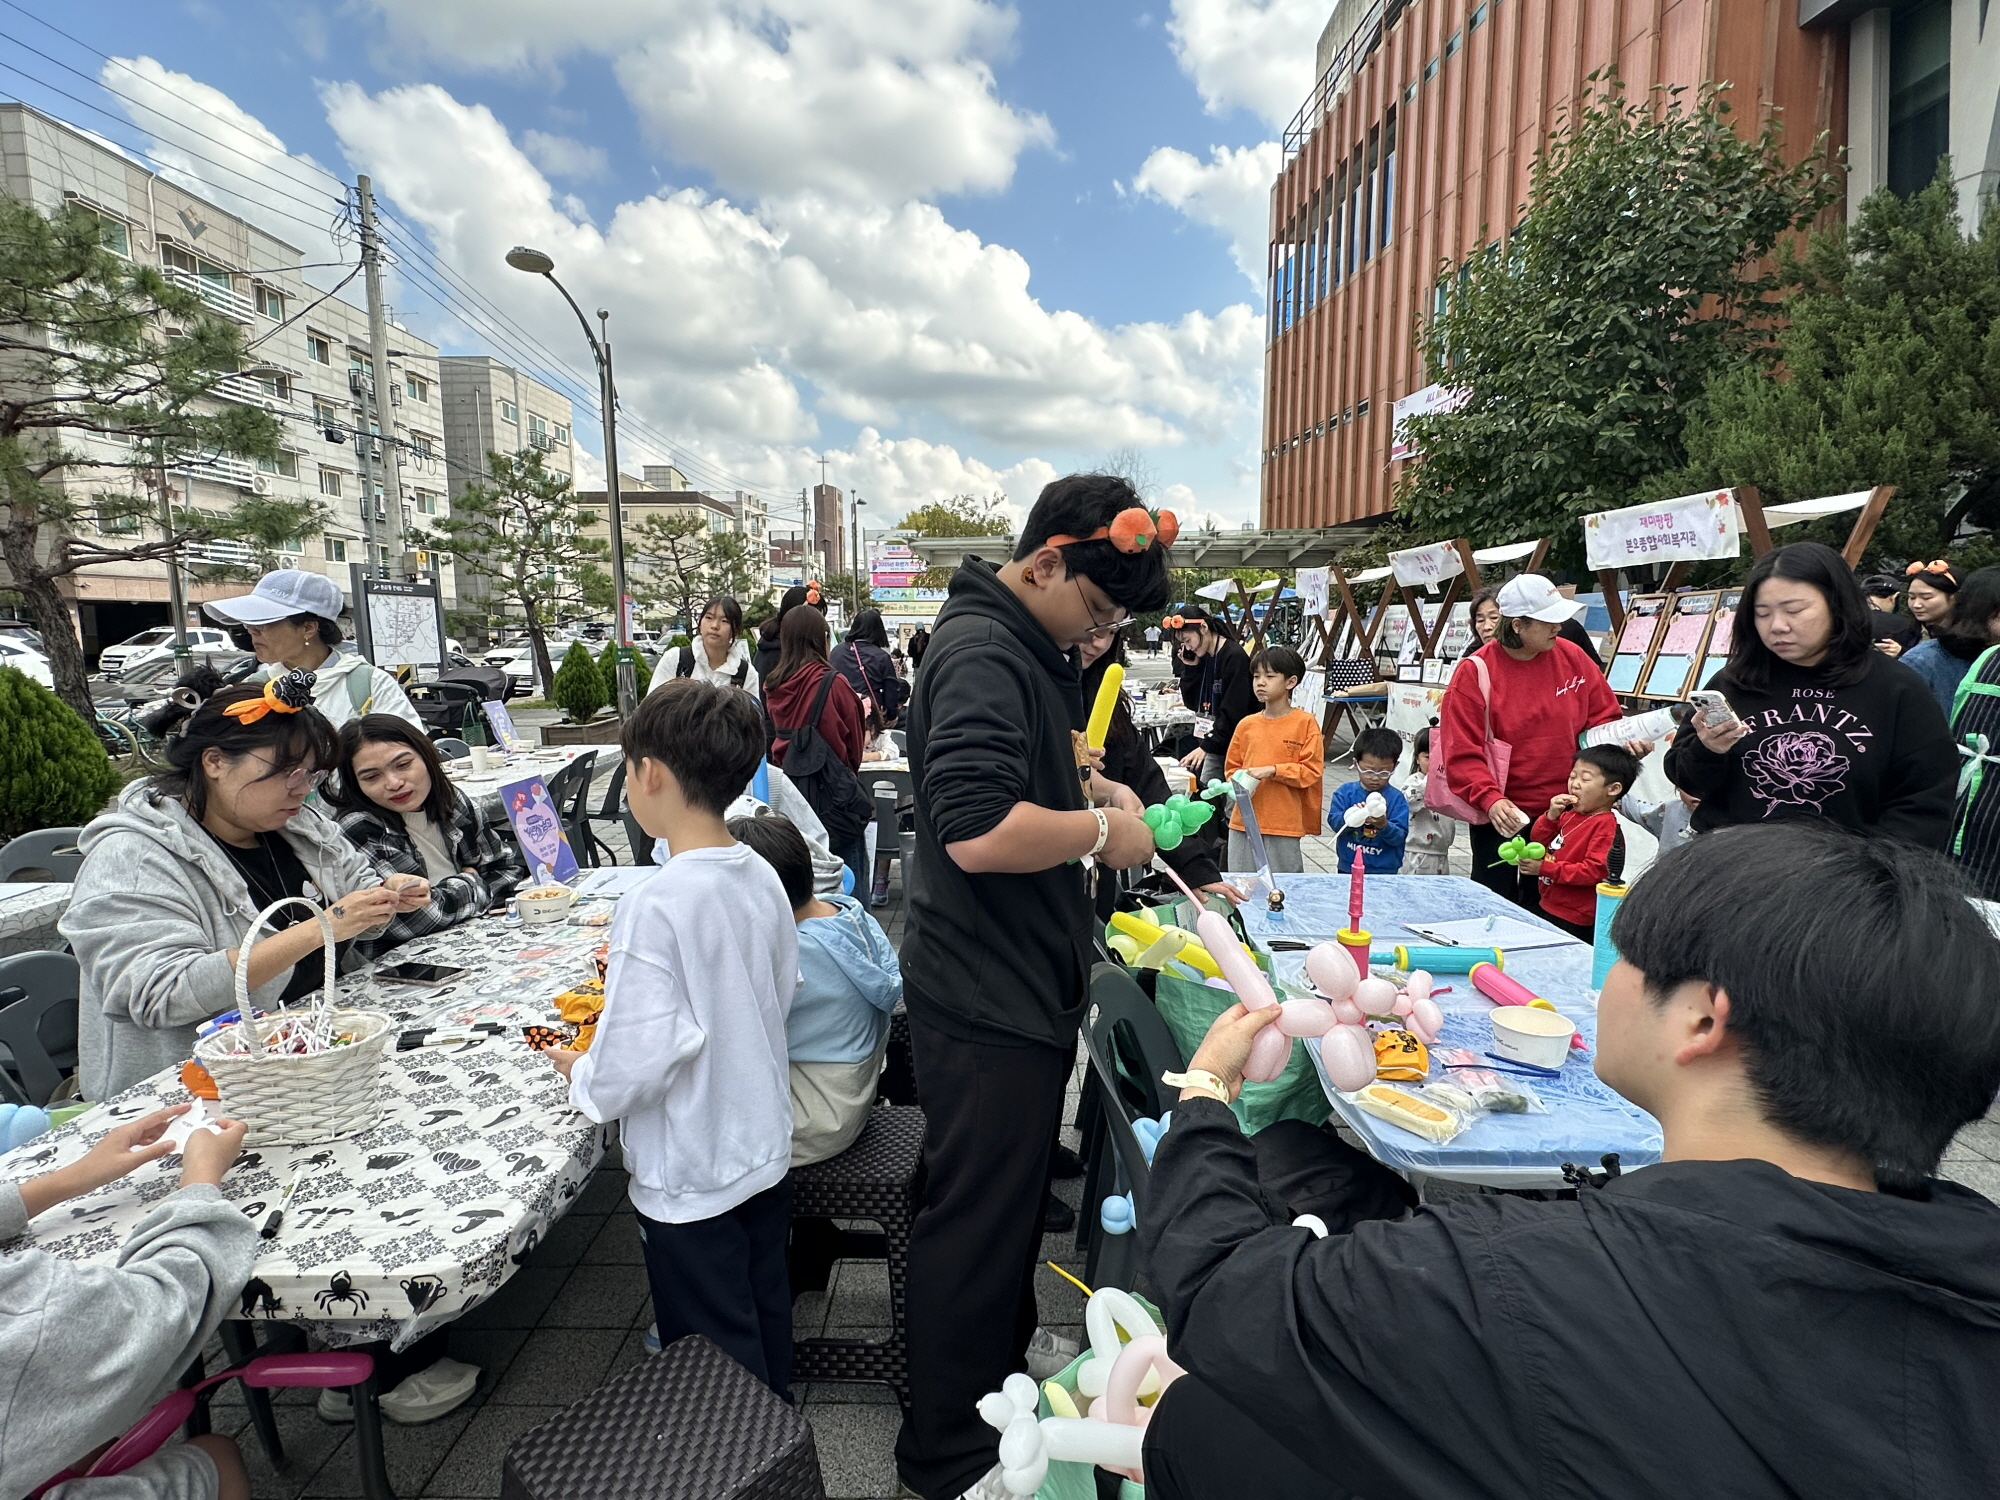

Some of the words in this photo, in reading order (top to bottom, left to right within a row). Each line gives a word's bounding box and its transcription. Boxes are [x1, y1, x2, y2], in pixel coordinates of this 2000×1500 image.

[1639, 513, 1673, 529] 재미팡팡
[1626, 531, 1697, 553] 본오종합사회복지관
[1791, 688, 1836, 699] ROSE
[1741, 702, 1874, 749] FRANTZ
[1346, 841, 1383, 856] MIKEY
